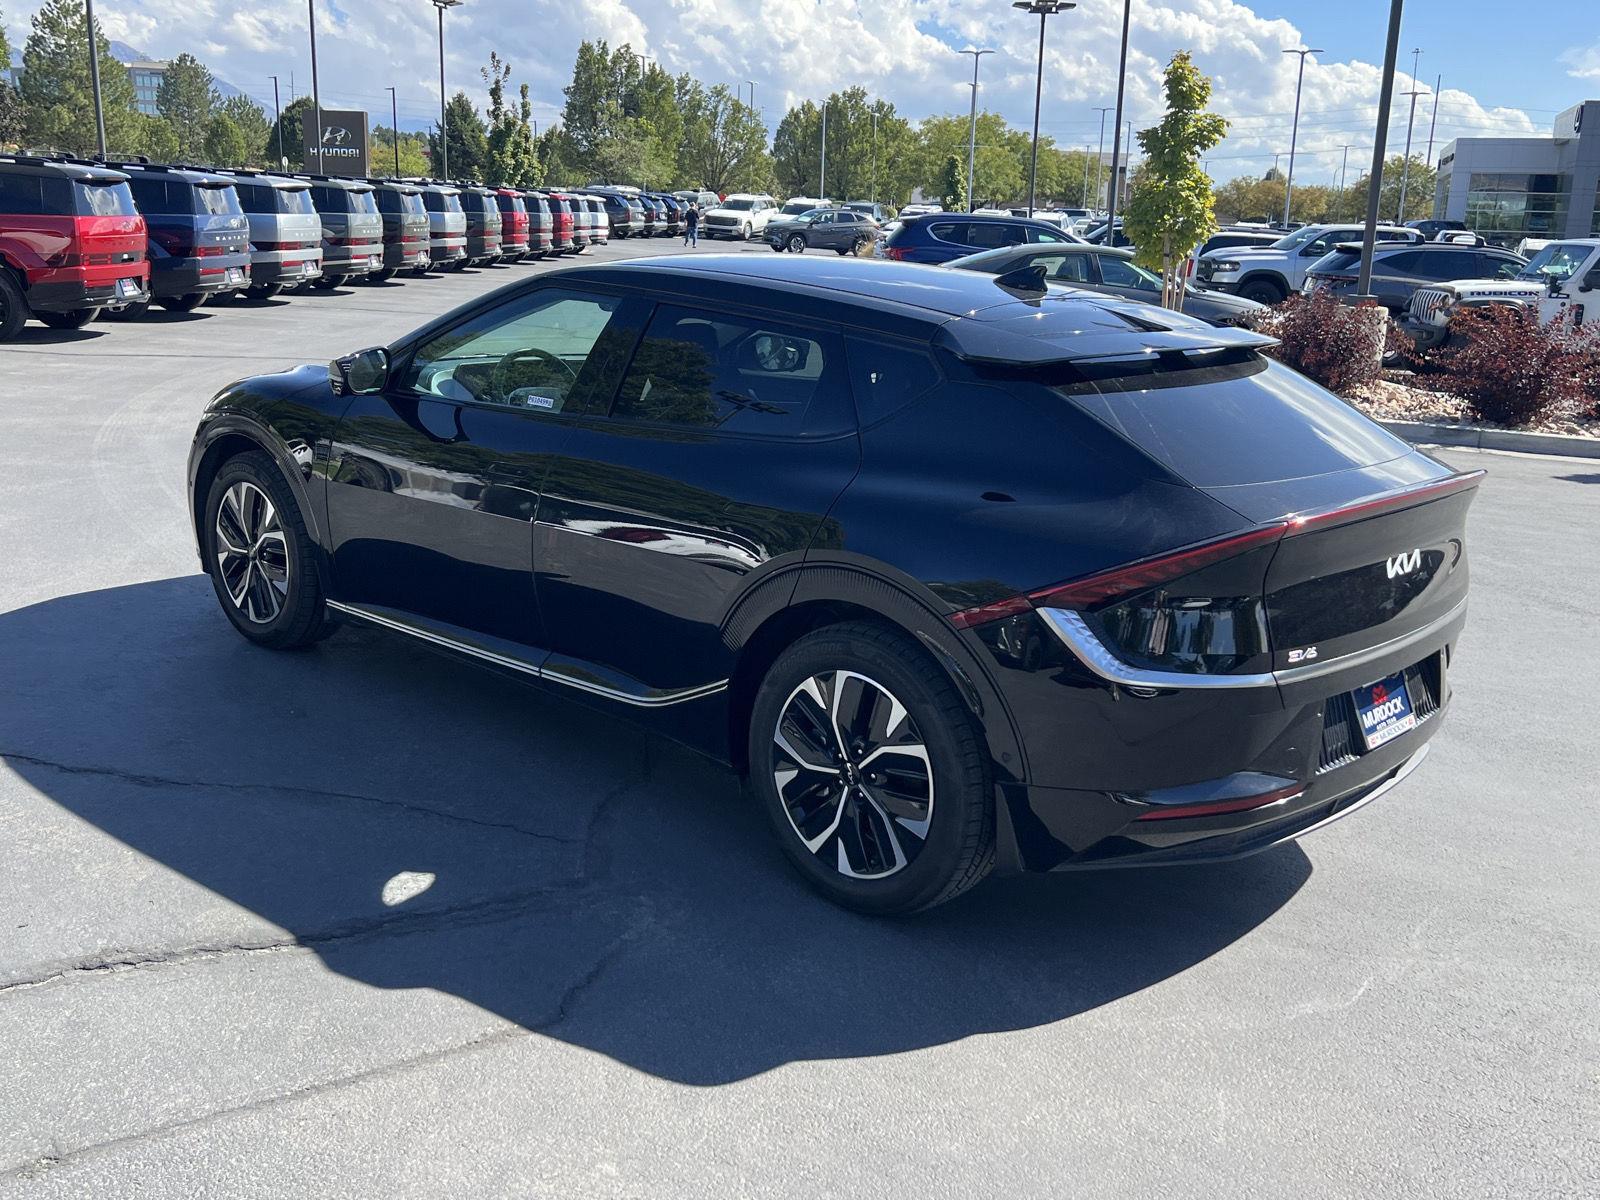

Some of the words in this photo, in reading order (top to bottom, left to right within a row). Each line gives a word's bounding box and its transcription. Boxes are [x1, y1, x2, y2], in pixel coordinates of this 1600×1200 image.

[309, 147, 360, 158] HYUNDAI
[1386, 548, 1421, 579] KIA
[1288, 646, 1318, 662] EV6
[1362, 696, 1405, 728] MURDOCK
